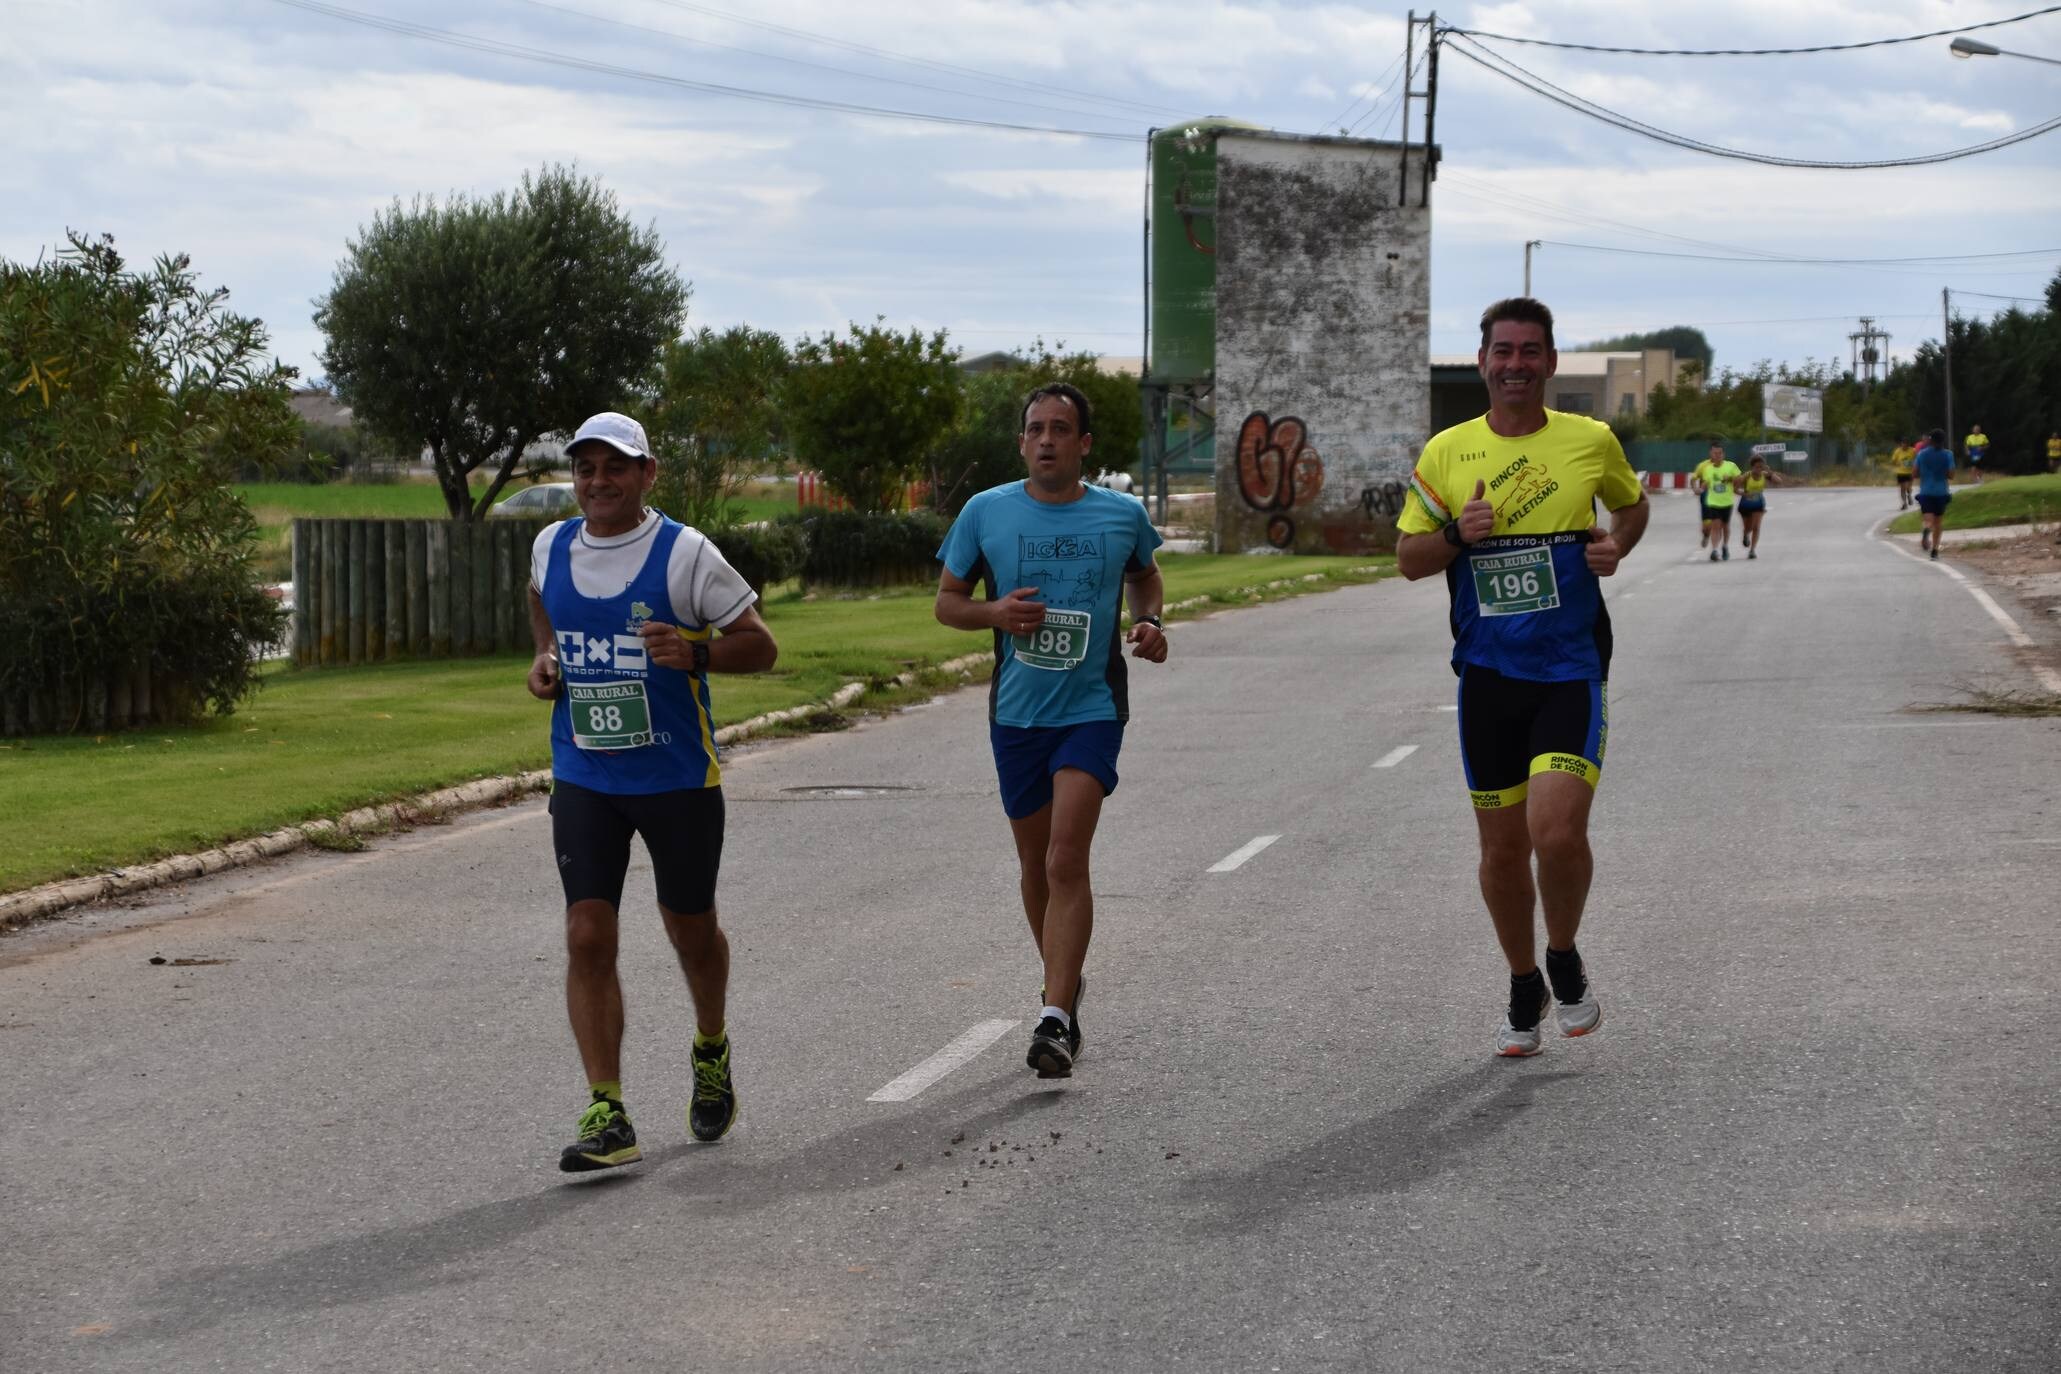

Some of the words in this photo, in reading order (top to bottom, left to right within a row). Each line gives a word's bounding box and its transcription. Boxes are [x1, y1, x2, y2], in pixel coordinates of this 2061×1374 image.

[1489, 454, 1529, 491] RINCON
[1507, 481, 1559, 527] ATLETISMO
[1513, 538, 1537, 546] SOTO
[1477, 559, 1501, 569] CAJA
[1504, 553, 1545, 568] RURAL
[1489, 571, 1540, 599] 196
[1044, 613, 1083, 626] RURAL
[1030, 630, 1071, 655] 198
[573, 687, 595, 699] CAJA
[596, 685, 638, 699] RURAL
[589, 705, 623, 731] 88
[1551, 756, 1588, 771] RINCÓN
[1565, 763, 1586, 777] SOTO
